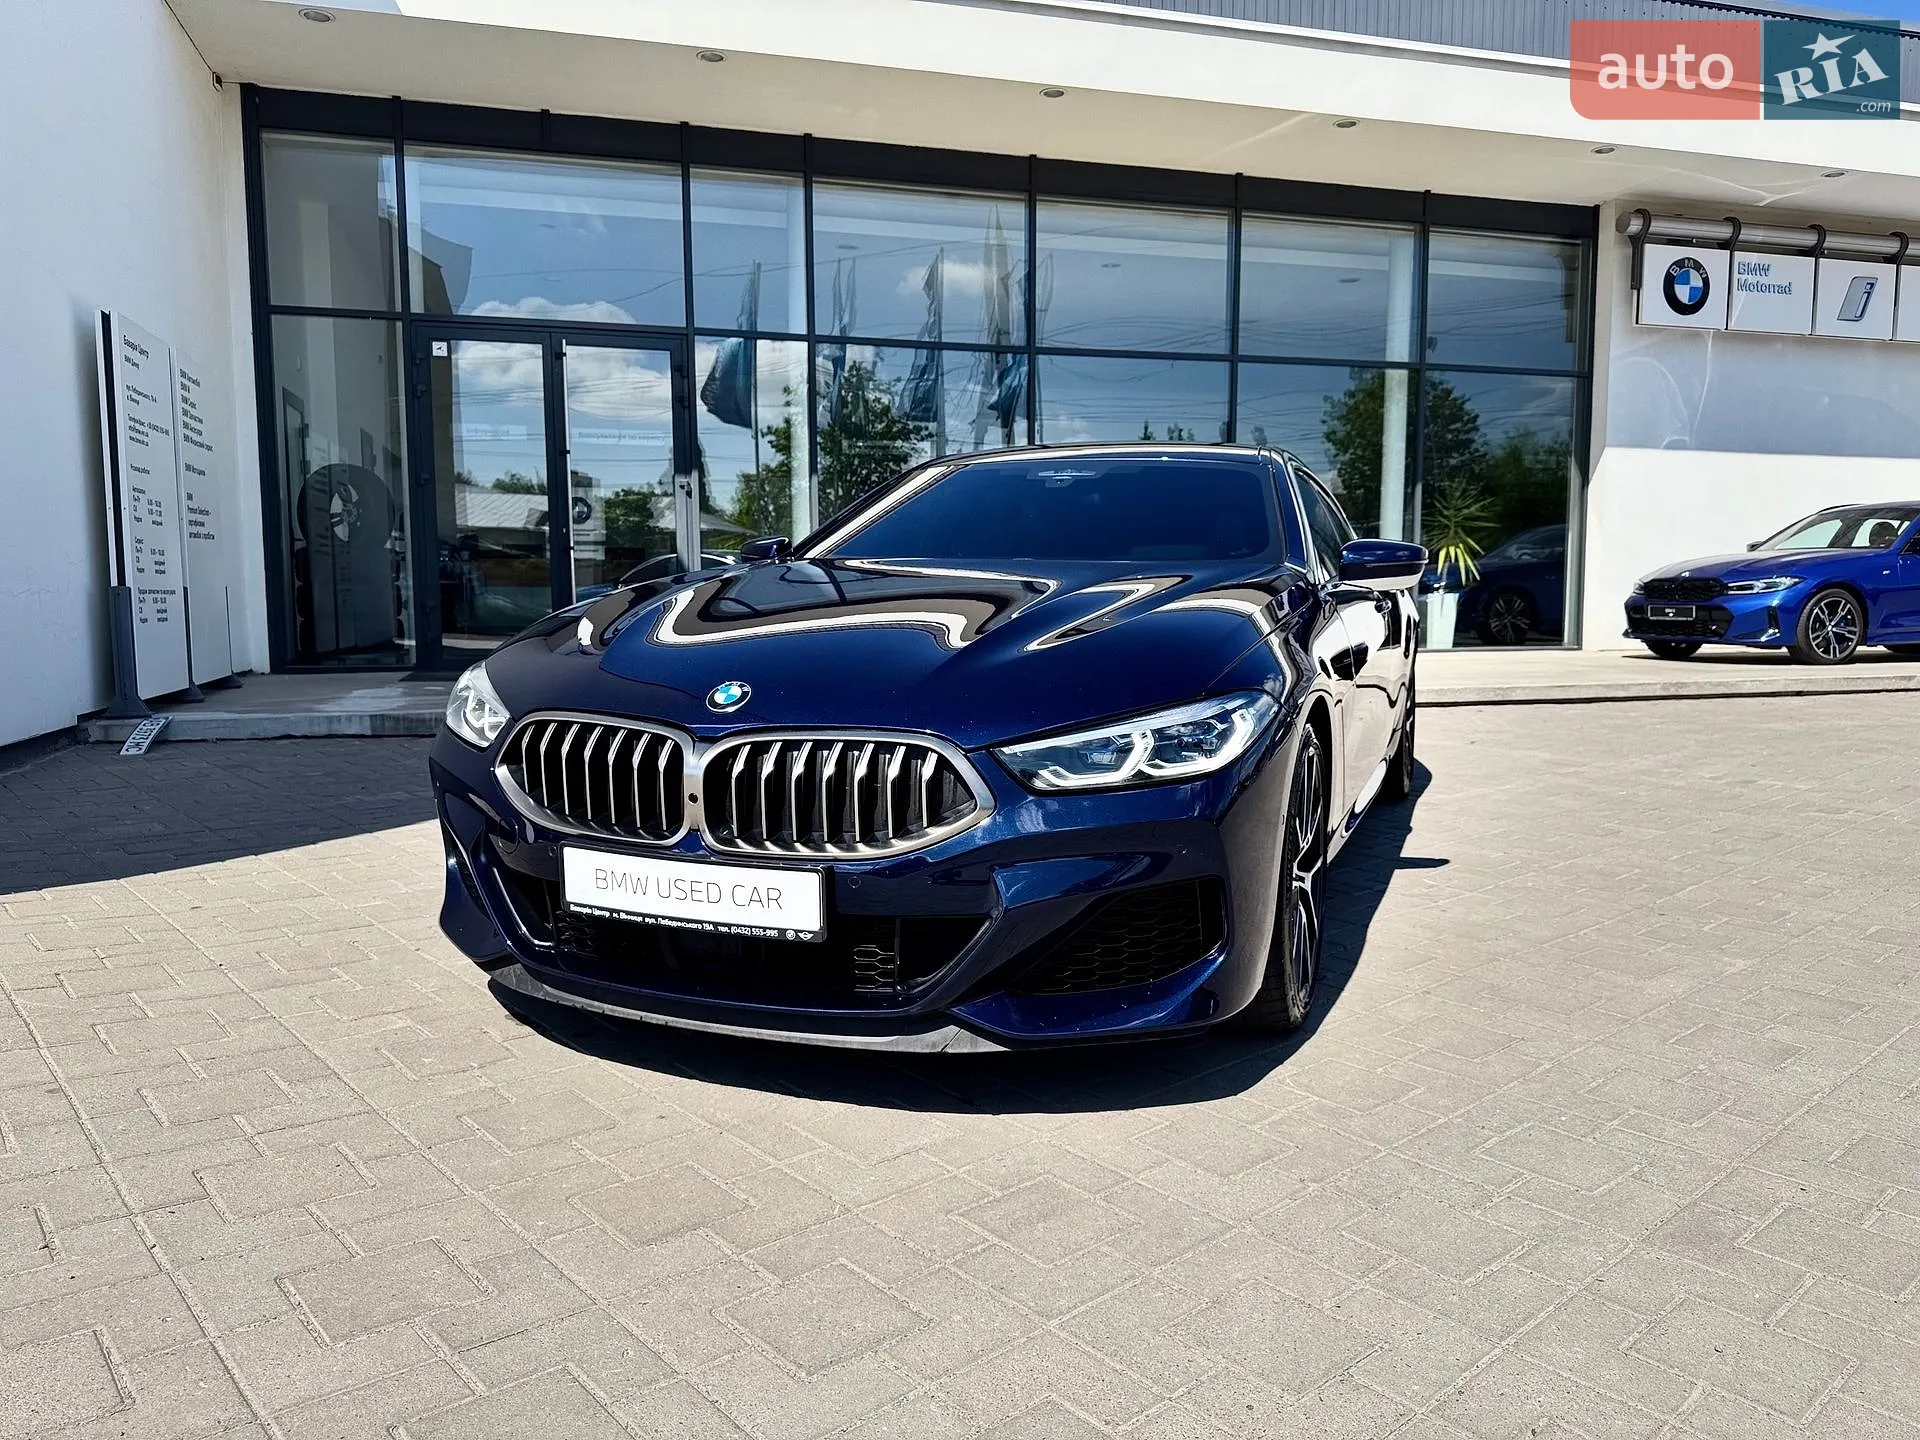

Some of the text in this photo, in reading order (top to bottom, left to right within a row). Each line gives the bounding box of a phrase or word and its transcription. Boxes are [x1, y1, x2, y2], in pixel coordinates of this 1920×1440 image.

[1737, 261, 1770, 277] BMW
[1736, 278, 1793, 296] Motorrad
[595, 868, 783, 910] BMW USED CAR
[730, 925, 751, 936] (0432)
[751, 928, 779, 938] 555-995
